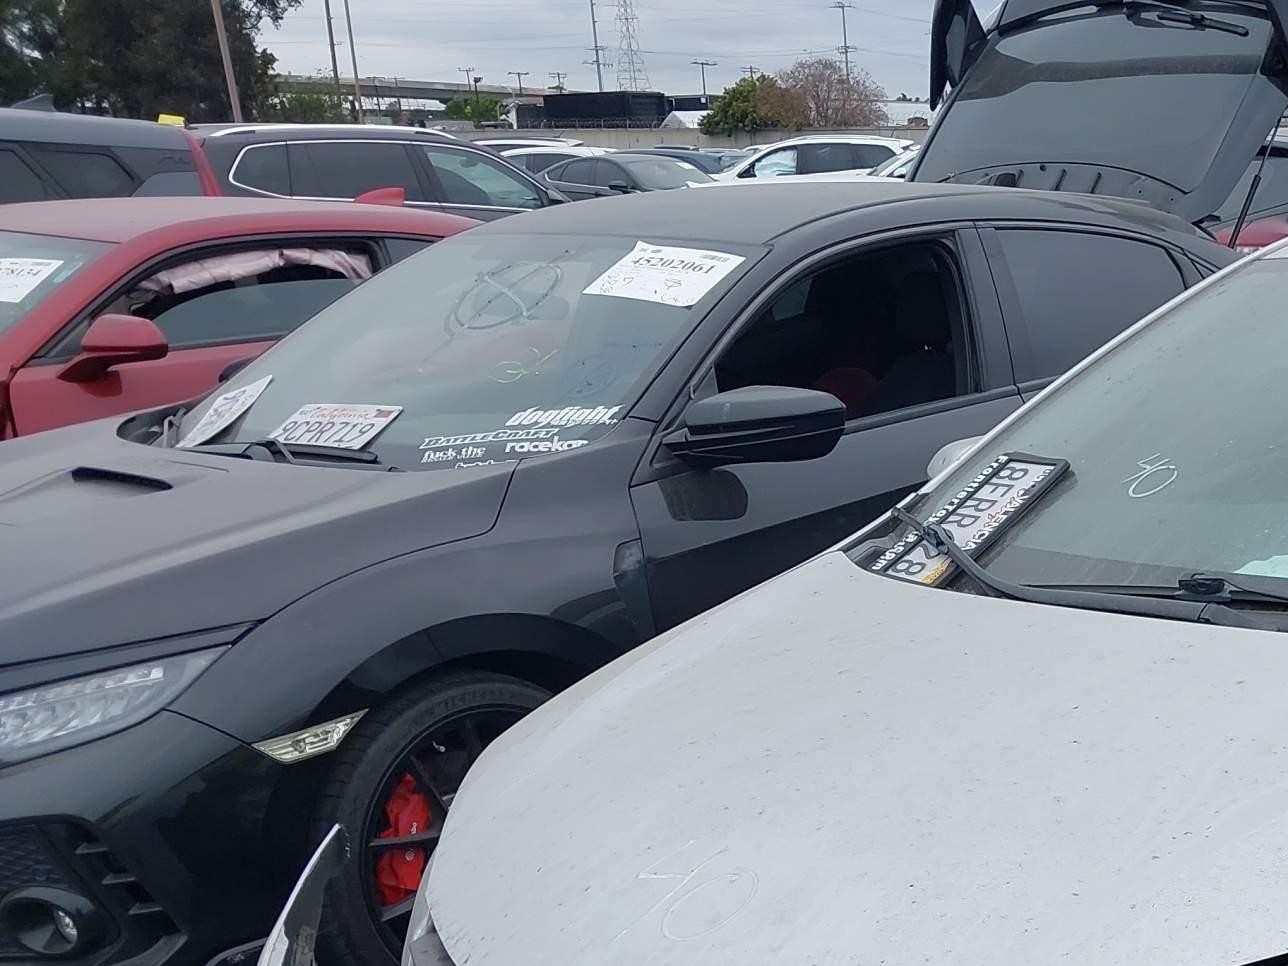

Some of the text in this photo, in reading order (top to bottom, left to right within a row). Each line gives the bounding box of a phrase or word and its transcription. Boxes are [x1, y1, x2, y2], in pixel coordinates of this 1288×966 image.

[631, 256, 717, 274] 45202061
[275, 420, 376, 443] 9CPR719
[960, 495, 1031, 551] VALENCIA
